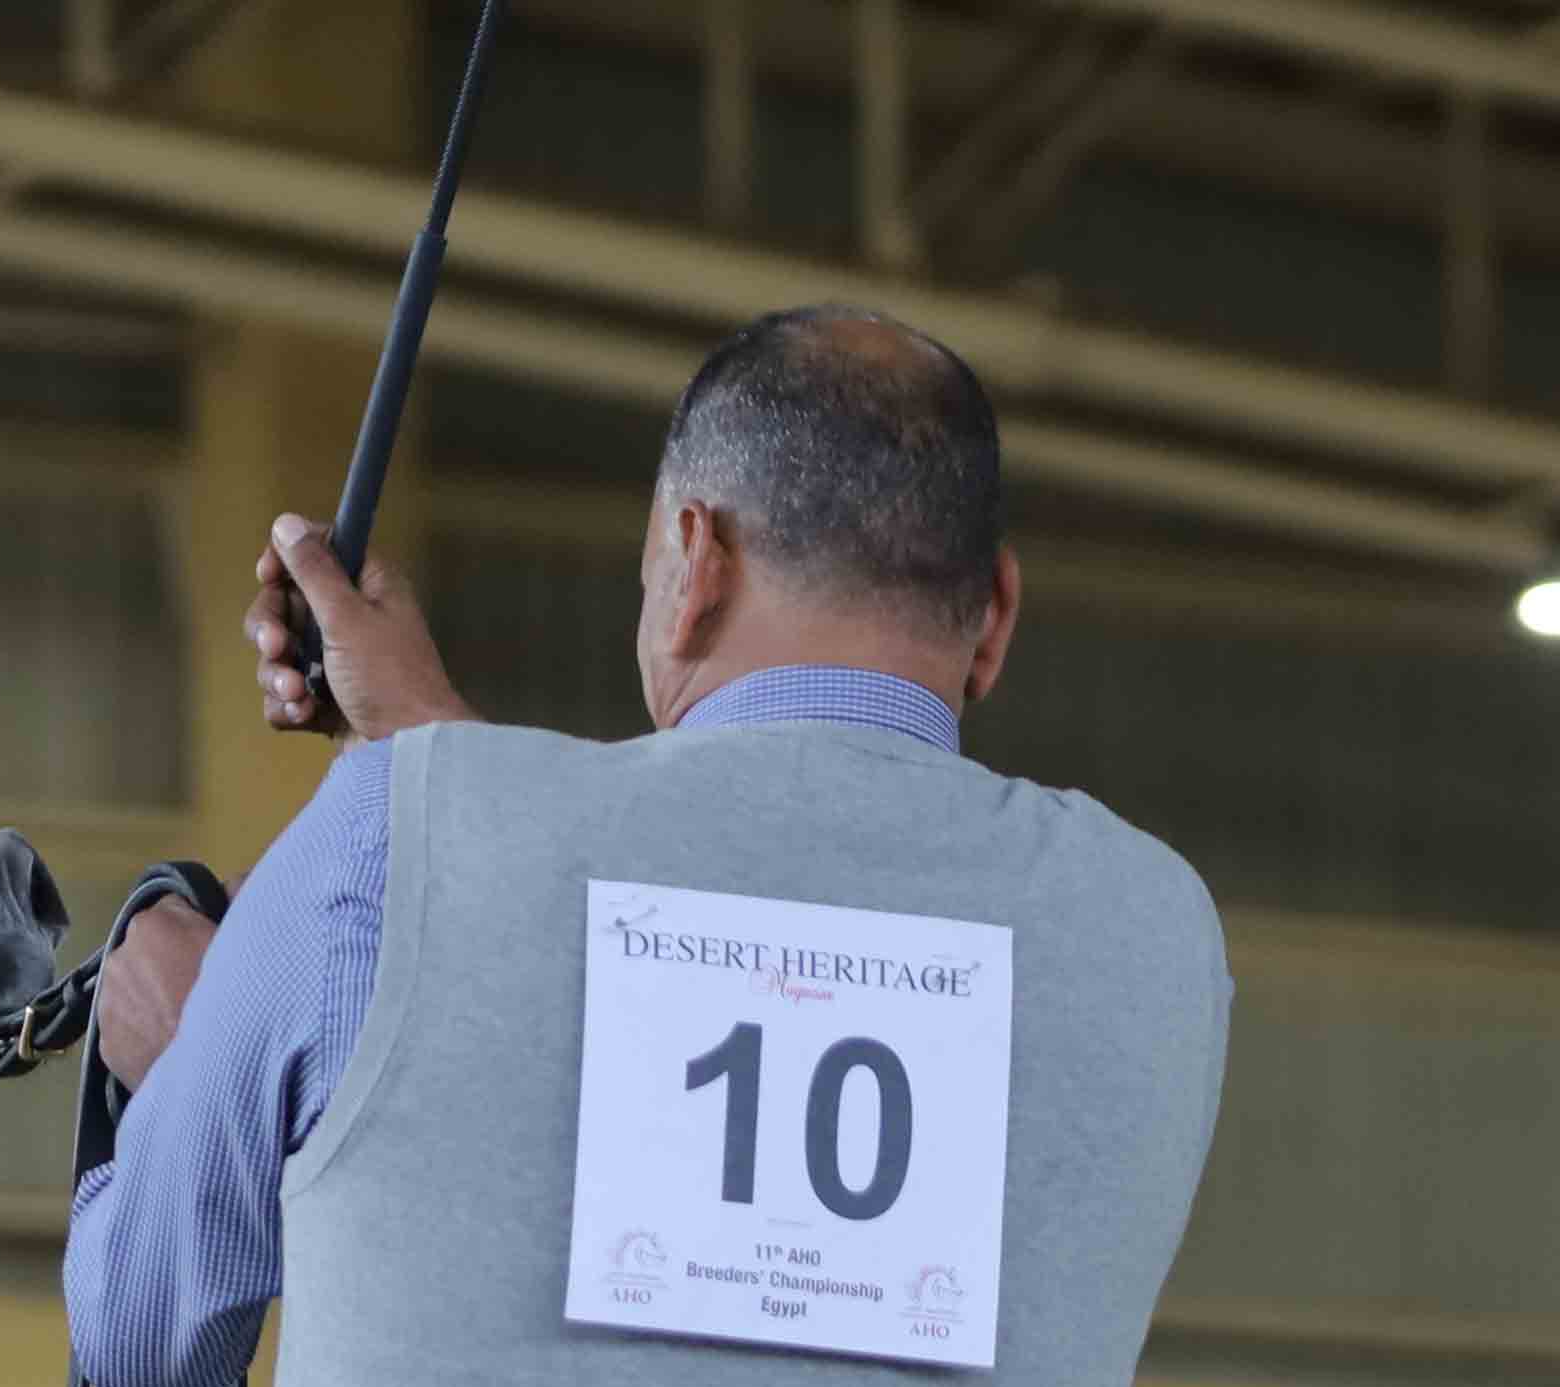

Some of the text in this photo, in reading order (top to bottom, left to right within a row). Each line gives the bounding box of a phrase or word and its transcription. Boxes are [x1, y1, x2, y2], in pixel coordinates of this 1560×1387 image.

[623, 929, 972, 998] DESERT HERITAGE
[686, 1021, 912, 1221] 10
[787, 1249, 821, 1266] AHO
[610, 1287, 652, 1305] AHO
[769, 1271, 884, 1302] Championship
[761, 1295, 807, 1319] Egypt
[908, 1322, 950, 1339] AHO
